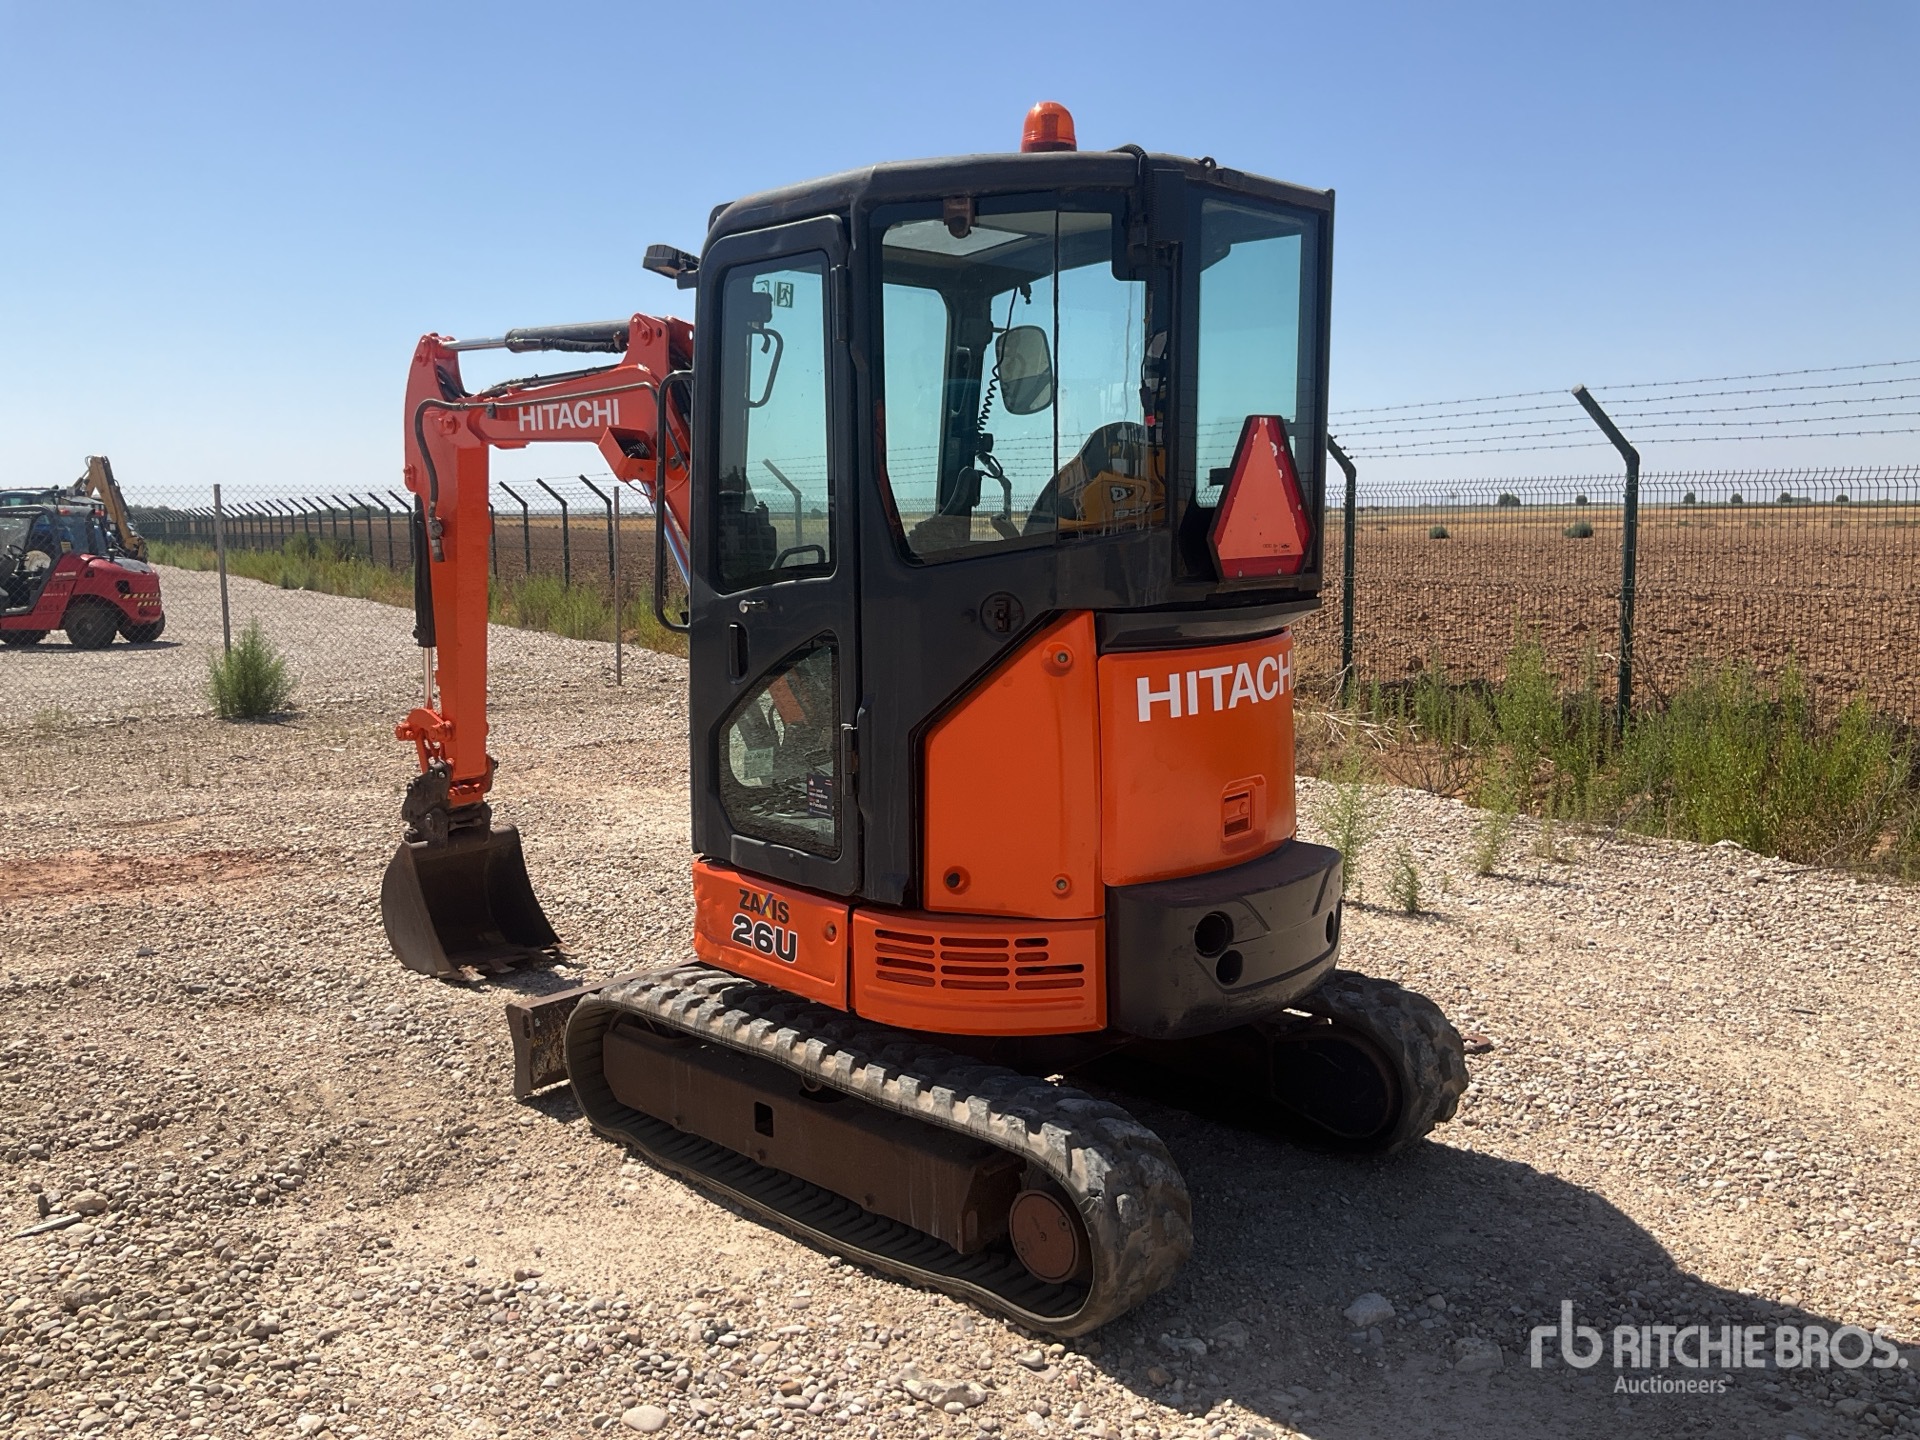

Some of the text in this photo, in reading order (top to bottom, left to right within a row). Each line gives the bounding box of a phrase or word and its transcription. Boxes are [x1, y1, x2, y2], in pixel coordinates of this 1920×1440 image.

[518, 398, 620, 432] HITACHI
[1136, 649, 1293, 722] HITACH
[739, 888, 790, 924] ZAXIS
[731, 912, 798, 964] 26U
